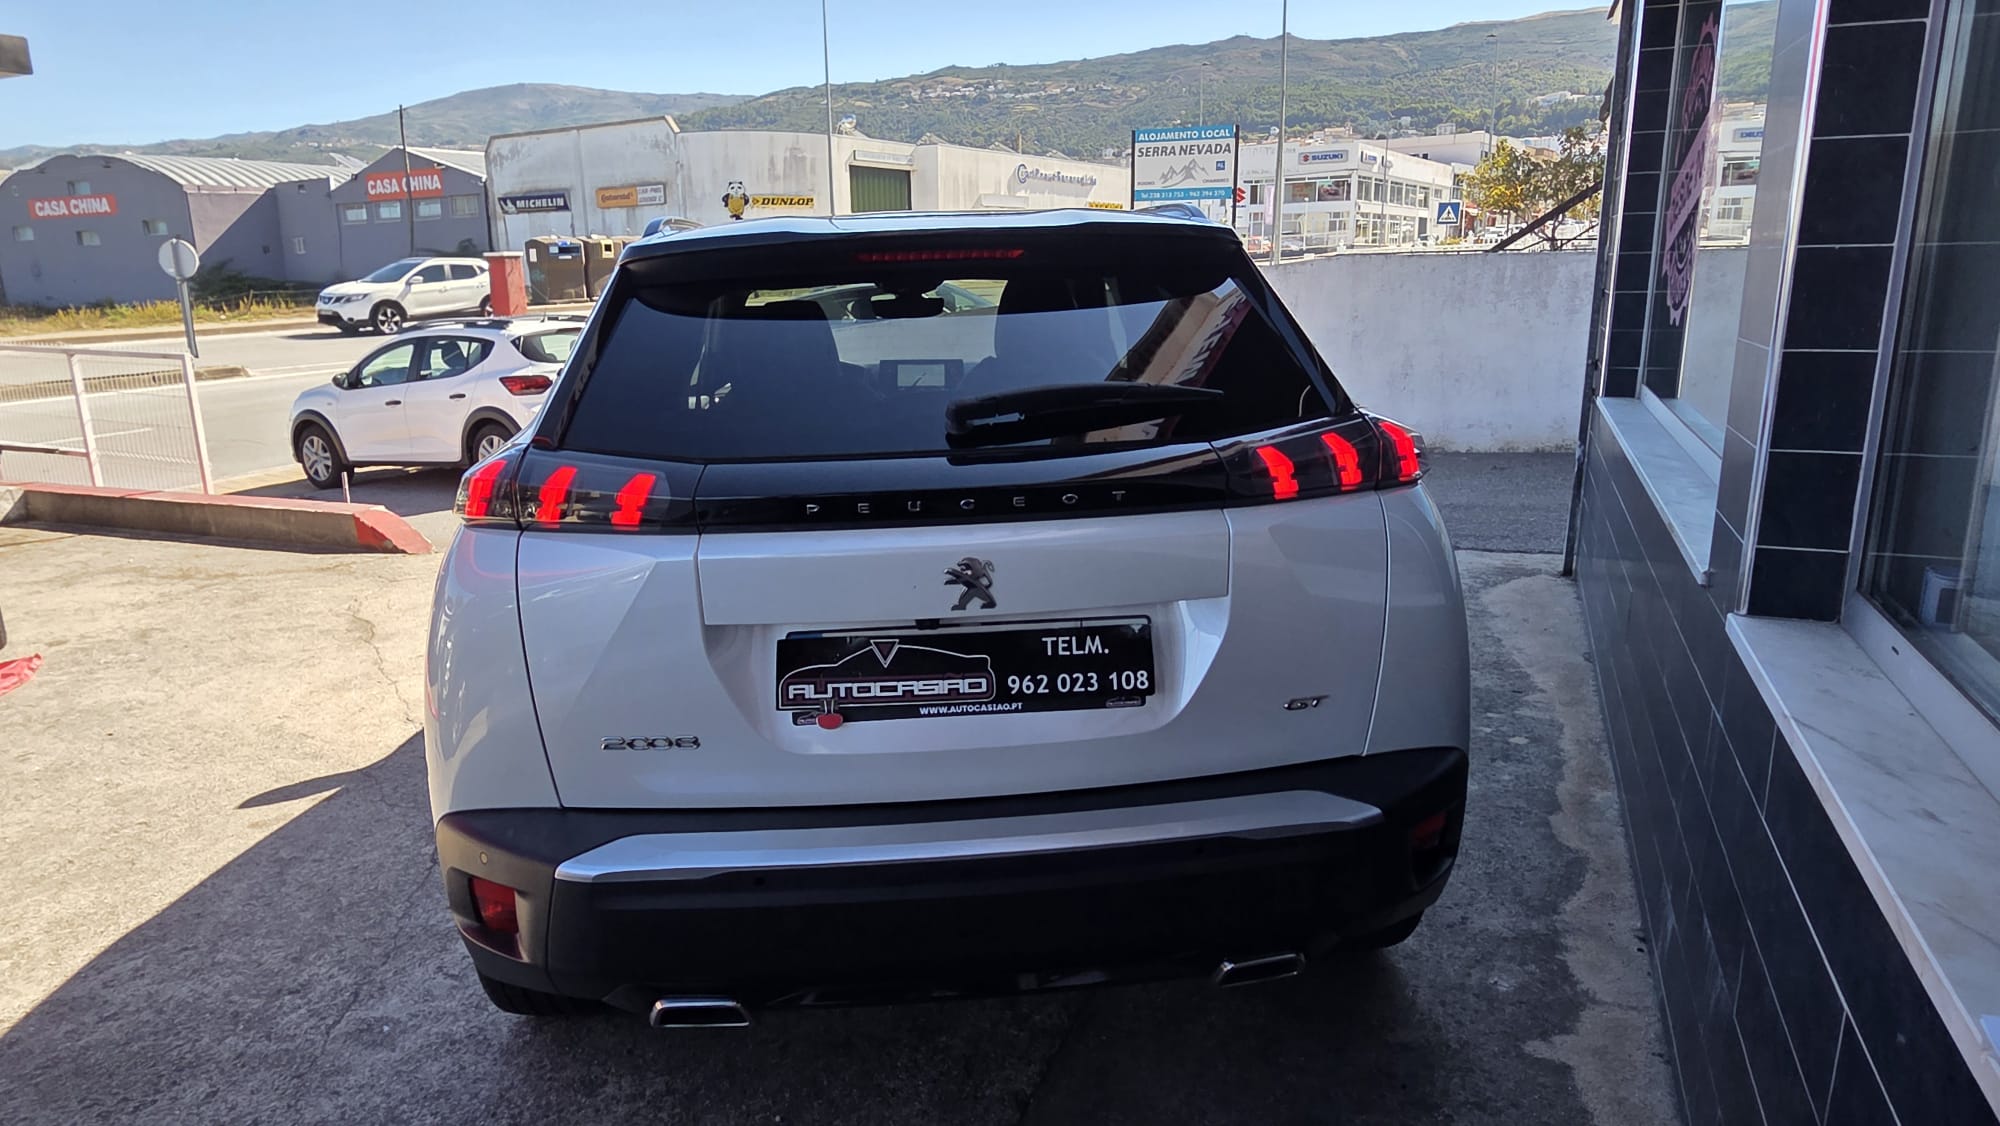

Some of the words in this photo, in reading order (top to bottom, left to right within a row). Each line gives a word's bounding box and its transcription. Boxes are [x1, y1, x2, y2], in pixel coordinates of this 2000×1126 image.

[1138, 131, 1198, 140] ALOJAMENTO
[1201, 128, 1231, 138] LOCAL
[1137, 145, 1176, 157] SERRA
[1179, 143, 1232, 156] NEVADA
[1311, 153, 1344, 161] SUZUKI
[367, 178, 400, 195] CASA
[35, 200, 69, 216] CASA
[69, 197, 111, 214] CHINA
[516, 197, 564, 208] MICHELIN
[760, 197, 814, 206] DUNLOP
[806, 490, 1126, 515] PEUGEOT
[1041, 635, 1109, 656] TELM.
[1007, 675, 1049, 695] 962
[1056, 672, 1099, 692] 023
[1108, 670, 1150, 691] 108
[1282, 694, 1330, 711] GT
[600, 735, 701, 751] 2008
